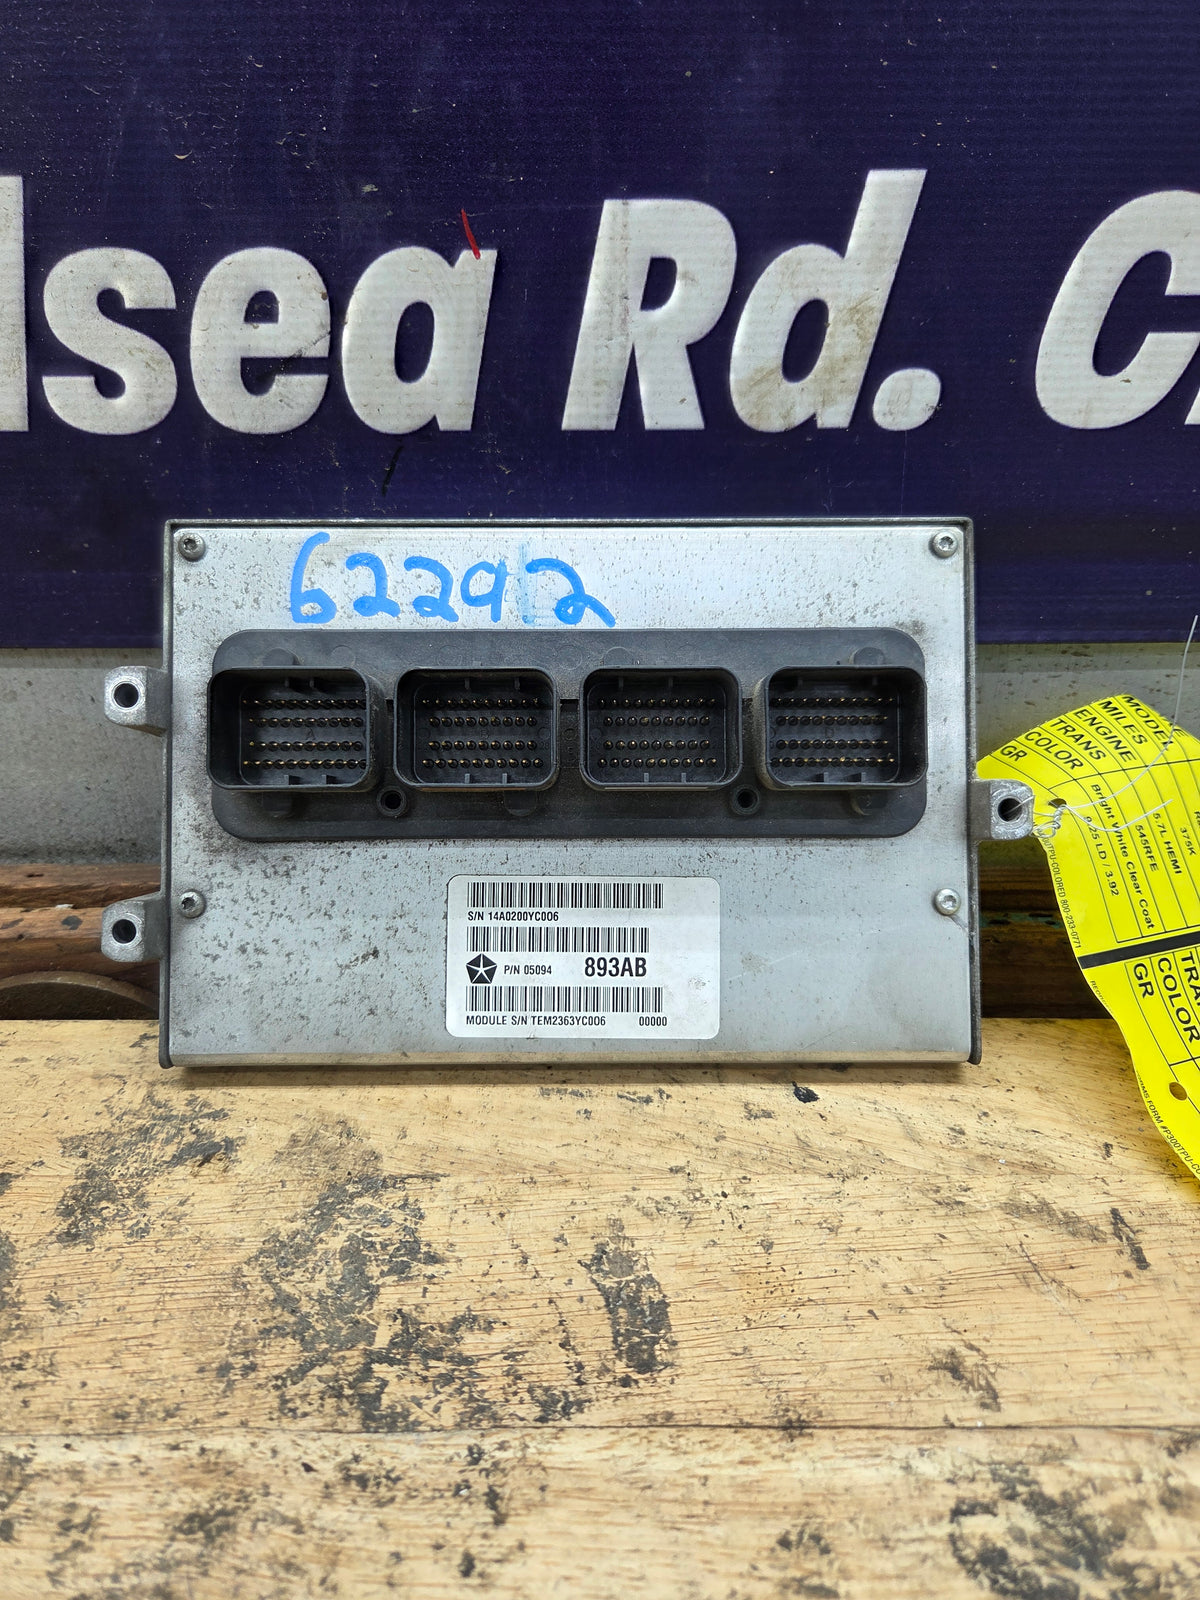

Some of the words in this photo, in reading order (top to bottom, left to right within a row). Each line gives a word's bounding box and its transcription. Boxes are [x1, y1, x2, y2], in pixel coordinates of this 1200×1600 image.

[561, 168, 942, 433] Rd.
[1035, 189, 1200, 430] C
[1049, 718, 1107, 761] TRANS
[1073, 708, 1137, 763] ENGINE
[1097, 700, 1148, 745] MILES
[1122, 696, 1174, 751] MODEL
[1000, 745, 1028, 762] GR
[1024, 731, 1084, 770] COLOR
[1091, 783, 1116, 820] Bright
[1111, 821, 1130, 858] White
[1126, 861, 1143, 895] Clear
[1138, 898, 1156, 930] Coat
[1095, 842, 1107, 860] LD
[1104, 870, 1120, 896] 3.92
[1135, 824, 1160, 872] 545RFE
[1163, 840, 1183, 874] HEMI
[467, 911, 484, 922] S/N
[487, 911, 559, 922] 14A0200YC006
[1060, 899, 1082, 949] 800-233-0771
[503, 964, 520, 976] P/N
[523, 964, 552, 976] 05094
[584, 957, 647, 978] 893AB
[1133, 963, 1155, 999] GR
[1181, 951, 1200, 1007] TRA
[466, 1015, 507, 1027] MODULE
[511, 1016, 527, 1027] S/N
[530, 1016, 606, 1027] TEM2363YC006
[638, 1017, 668, 1027] 00000
[1158, 957, 1200, 1043] COLOR
[1147, 1100, 1164, 1124] FORM
